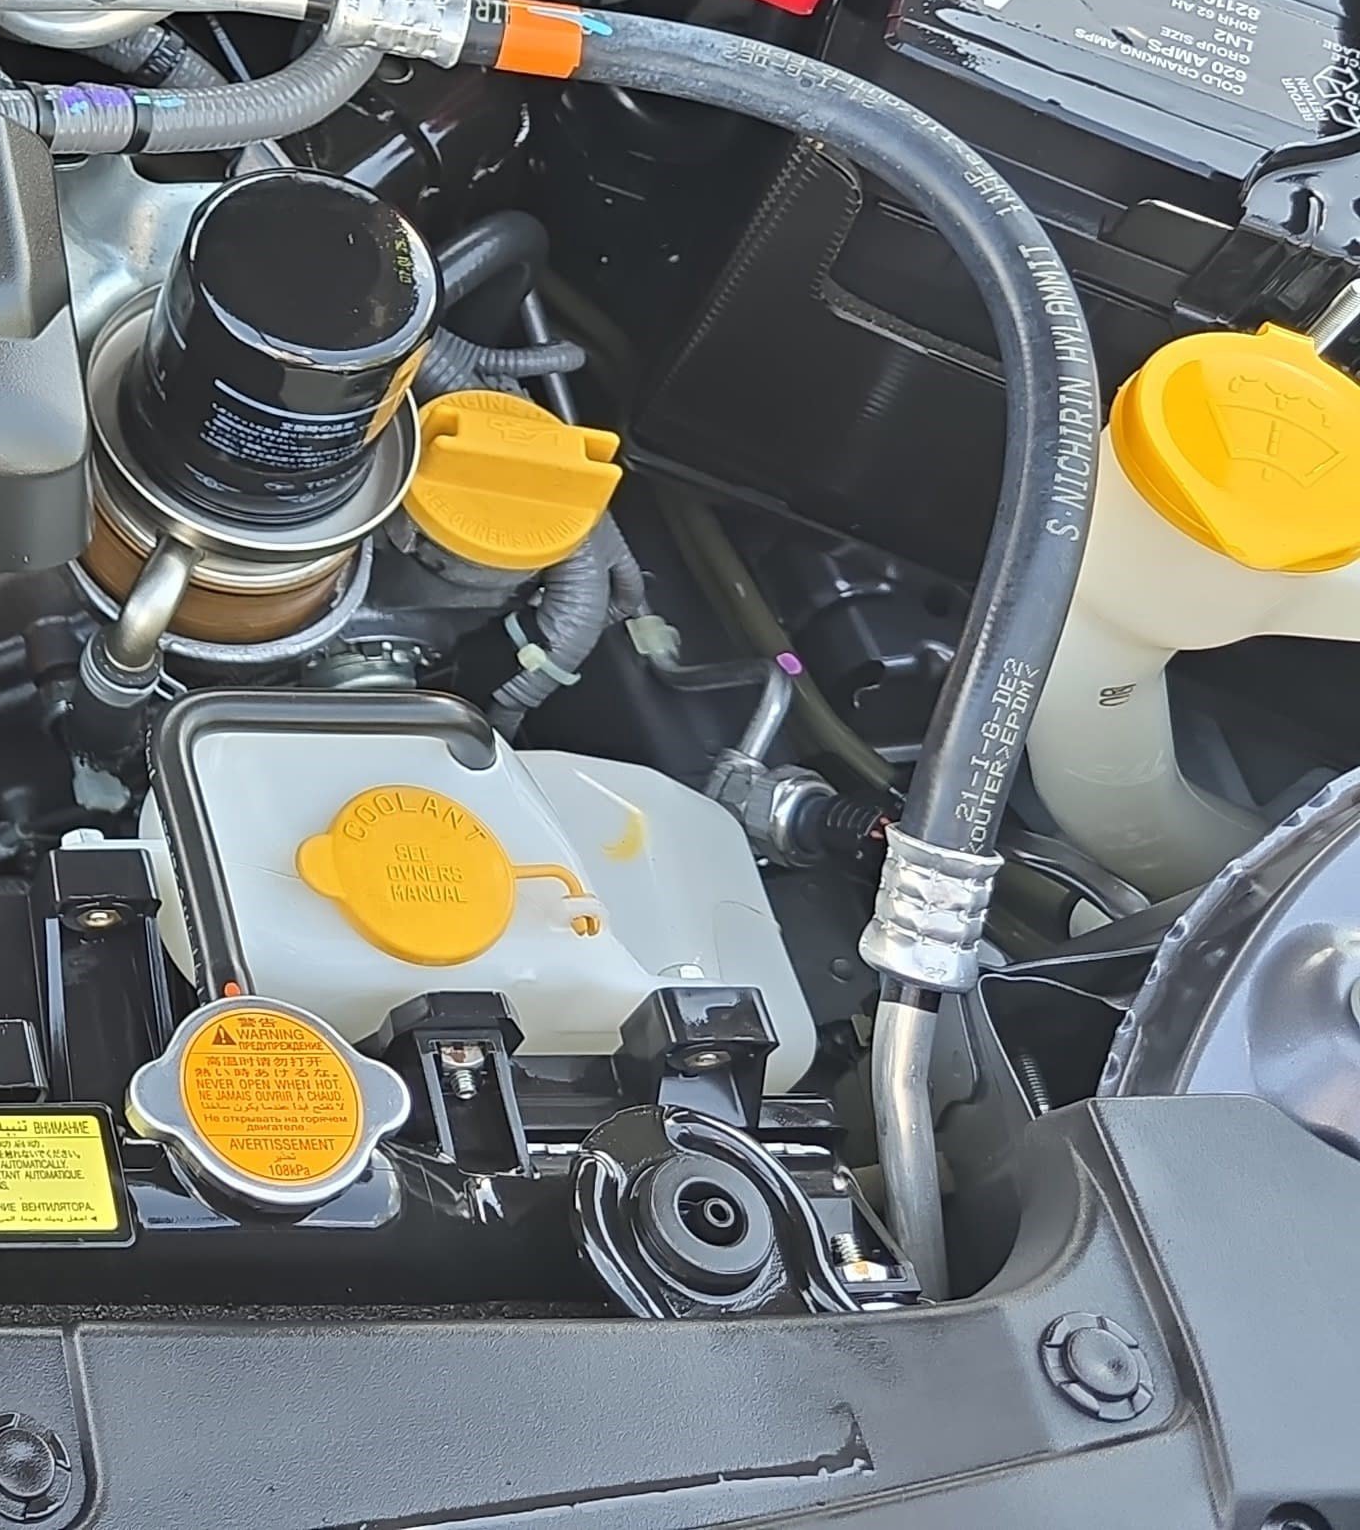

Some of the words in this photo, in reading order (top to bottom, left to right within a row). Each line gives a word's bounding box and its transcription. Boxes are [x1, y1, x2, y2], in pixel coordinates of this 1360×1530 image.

[1197, 7, 1215, 19] 62
[1217, 13, 1258, 34] 20HR
[1074, 27, 1119, 50] AMPS
[1160, 26, 1194, 45] SIZE
[1213, 28, 1254, 53] LN2
[1120, 44, 1199, 79] CRANKING
[1147, 38, 1208, 68] AMPS
[1196, 41, 1251, 65] GROUP
[1211, 61, 1247, 83] 620
[1202, 72, 1244, 96] COLD
[1281, 77, 1316, 122] RETOUR
[1294, 77, 1330, 121] RETURN
[963, 170, 1008, 216] 11HP
[1017, 244, 1089, 364] HYLAMMIT
[954, 657, 1024, 823] 21-I-G-DE2
[343, 792, 487, 843] COOLANT
[393, 844, 433, 863] SEE
[390, 883, 469, 903] MANUAL
[236, 1029, 305, 1041] WARNING
[238, 1041, 324, 1052] ПРЕДУПРЕЖДЕНИЕ
[196, 1079, 234, 1090] NEVER
[239, 1079, 271, 1090] OPEN
[274, 1079, 310, 1090] WHEN
[315, 1079, 343, 1090] HOT.
[199, 1091, 213, 1101] NE
[215, 1090, 251, 1101] JAMAIS
[255, 1090, 293, 1101] OUVRIR
[307, 1090, 345, 1102] CHAUD.
[33, 1121, 90, 1134] ВНИМАНИЕ
[204, 1113, 219, 1123] Не
[223, 1115, 280, 1124] открывать
[284, 1115, 298, 1123] на
[304, 1115, 348, 1124] горячем
[230, 1138, 336, 1151] AVERTISSEMENT
[1, 1160, 69, 1169] AUTOMATICALLY.
[269, 1164, 311, 1176] 108kPa
[25, 1170, 85, 1181] AUTOMATIQUE.
[21, 1202, 95, 1211] ВЕНТИЛЯТОРА.
